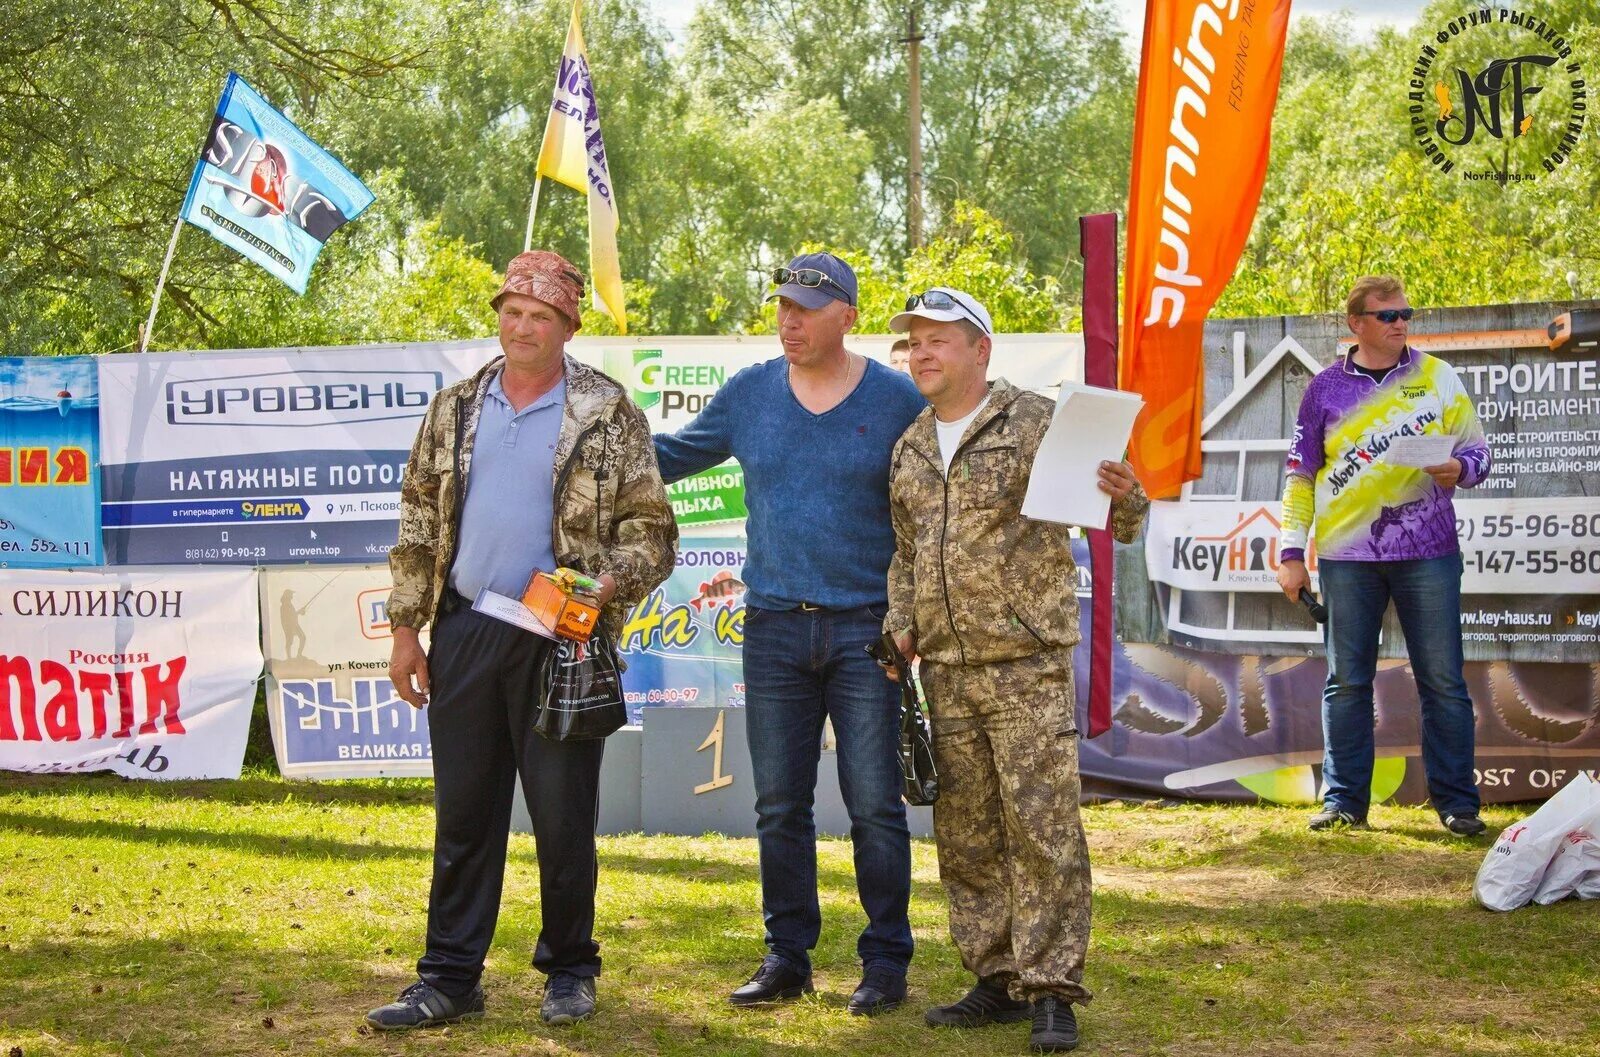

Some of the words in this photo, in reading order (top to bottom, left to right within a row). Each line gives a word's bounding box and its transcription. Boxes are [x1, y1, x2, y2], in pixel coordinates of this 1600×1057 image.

[1228, 31, 1249, 112] FISHING
[1453, 361, 1600, 394] ТРОИТЕ
[181, 382, 429, 415] УРОВЕНЬ
[1486, 432, 1516, 444] СНОЕ
[1494, 448, 1525, 459] БАНИ
[1527, 448, 1542, 457] ИЗ
[1490, 462, 1533, 473] МЕНТЫ:
[169, 466, 317, 491] НАТЯЖНЫЕ
[179, 506, 234, 518] гипермаркете
[253, 501, 304, 517] ЛЕНТА
[339, 504, 357, 513] ул.
[672, 496, 726, 516] ДЫХА
[0, 541, 25, 552] ел.
[30, 539, 59, 552] 552
[64, 541, 90, 555] 111
[185, 548, 219, 560] 8(8162)
[221, 547, 266, 558] 90-90-23
[289, 545, 341, 558] uroven.top
[1466, 550, 1600, 574] -147-55-80
[13, 590, 183, 618] СИЛИКОН
[1500, 631, 1550, 642] территория
[1551, 630, 1596, 641] торгового
[69, 649, 150, 665] Россия
[328, 663, 345, 674] ул.
[338, 744, 422, 759] ВЕЛИКАЯ
[694, 710, 733, 795] 1
[1528, 769, 1566, 788] OF
